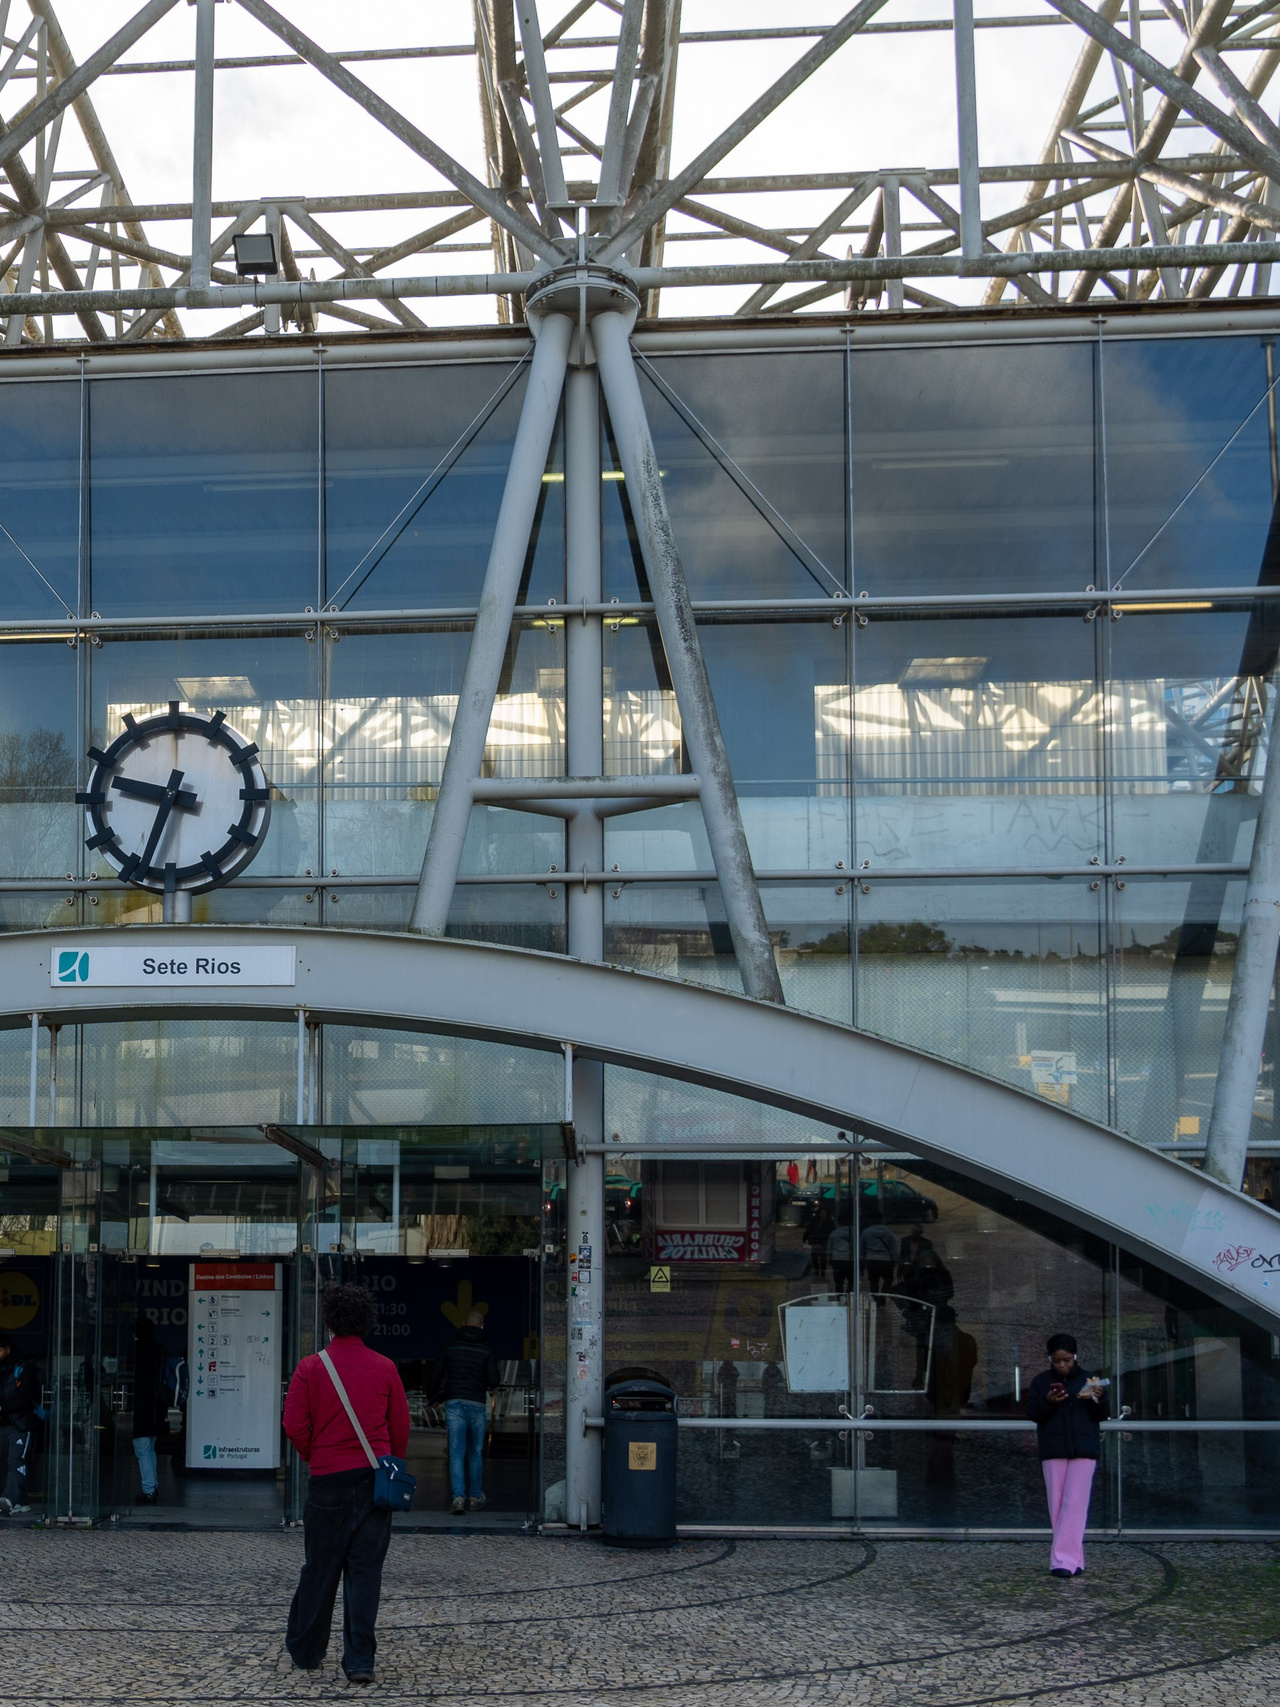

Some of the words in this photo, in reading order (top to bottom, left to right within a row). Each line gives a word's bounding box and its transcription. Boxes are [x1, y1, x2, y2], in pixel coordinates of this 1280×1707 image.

[142, 957, 188, 975] Sete
[195, 957, 241, 975] Rios
[373, 1323, 411, 1336] 21:00
[218, 1446, 261, 1454] Infraestruturas
[226, 1452, 248, 1461] Portugal
